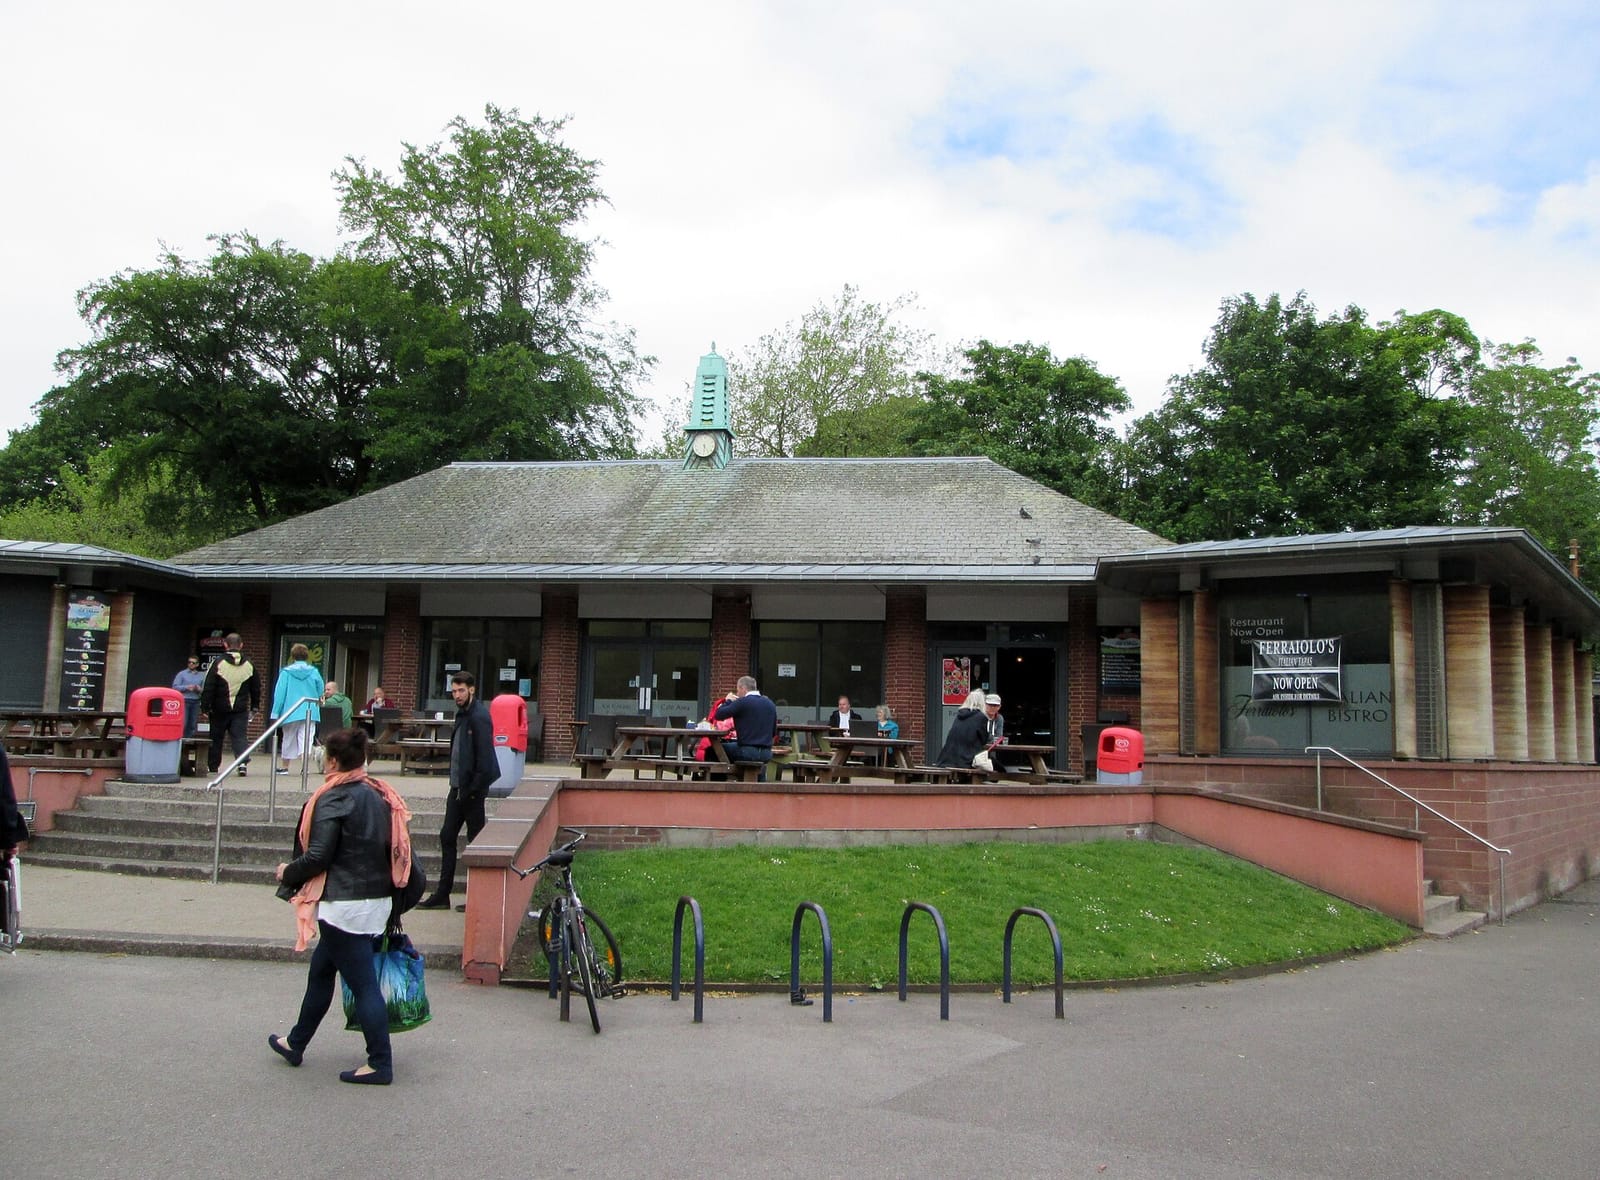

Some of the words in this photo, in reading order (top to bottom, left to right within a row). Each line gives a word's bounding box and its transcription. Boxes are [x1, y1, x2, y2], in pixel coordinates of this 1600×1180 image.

[1230, 618, 1284, 627] Restaurant
[1230, 628, 1253, 636] Now
[1255, 627, 1284, 637] Open
[1259, 639, 1335, 655] FERRAIOLO'S
[1273, 677, 1293, 690] NOW
[1294, 677, 1318, 690] OPEN
[1341, 691, 1392, 704] ALIAN
[1328, 709, 1388, 722] BISTRO
